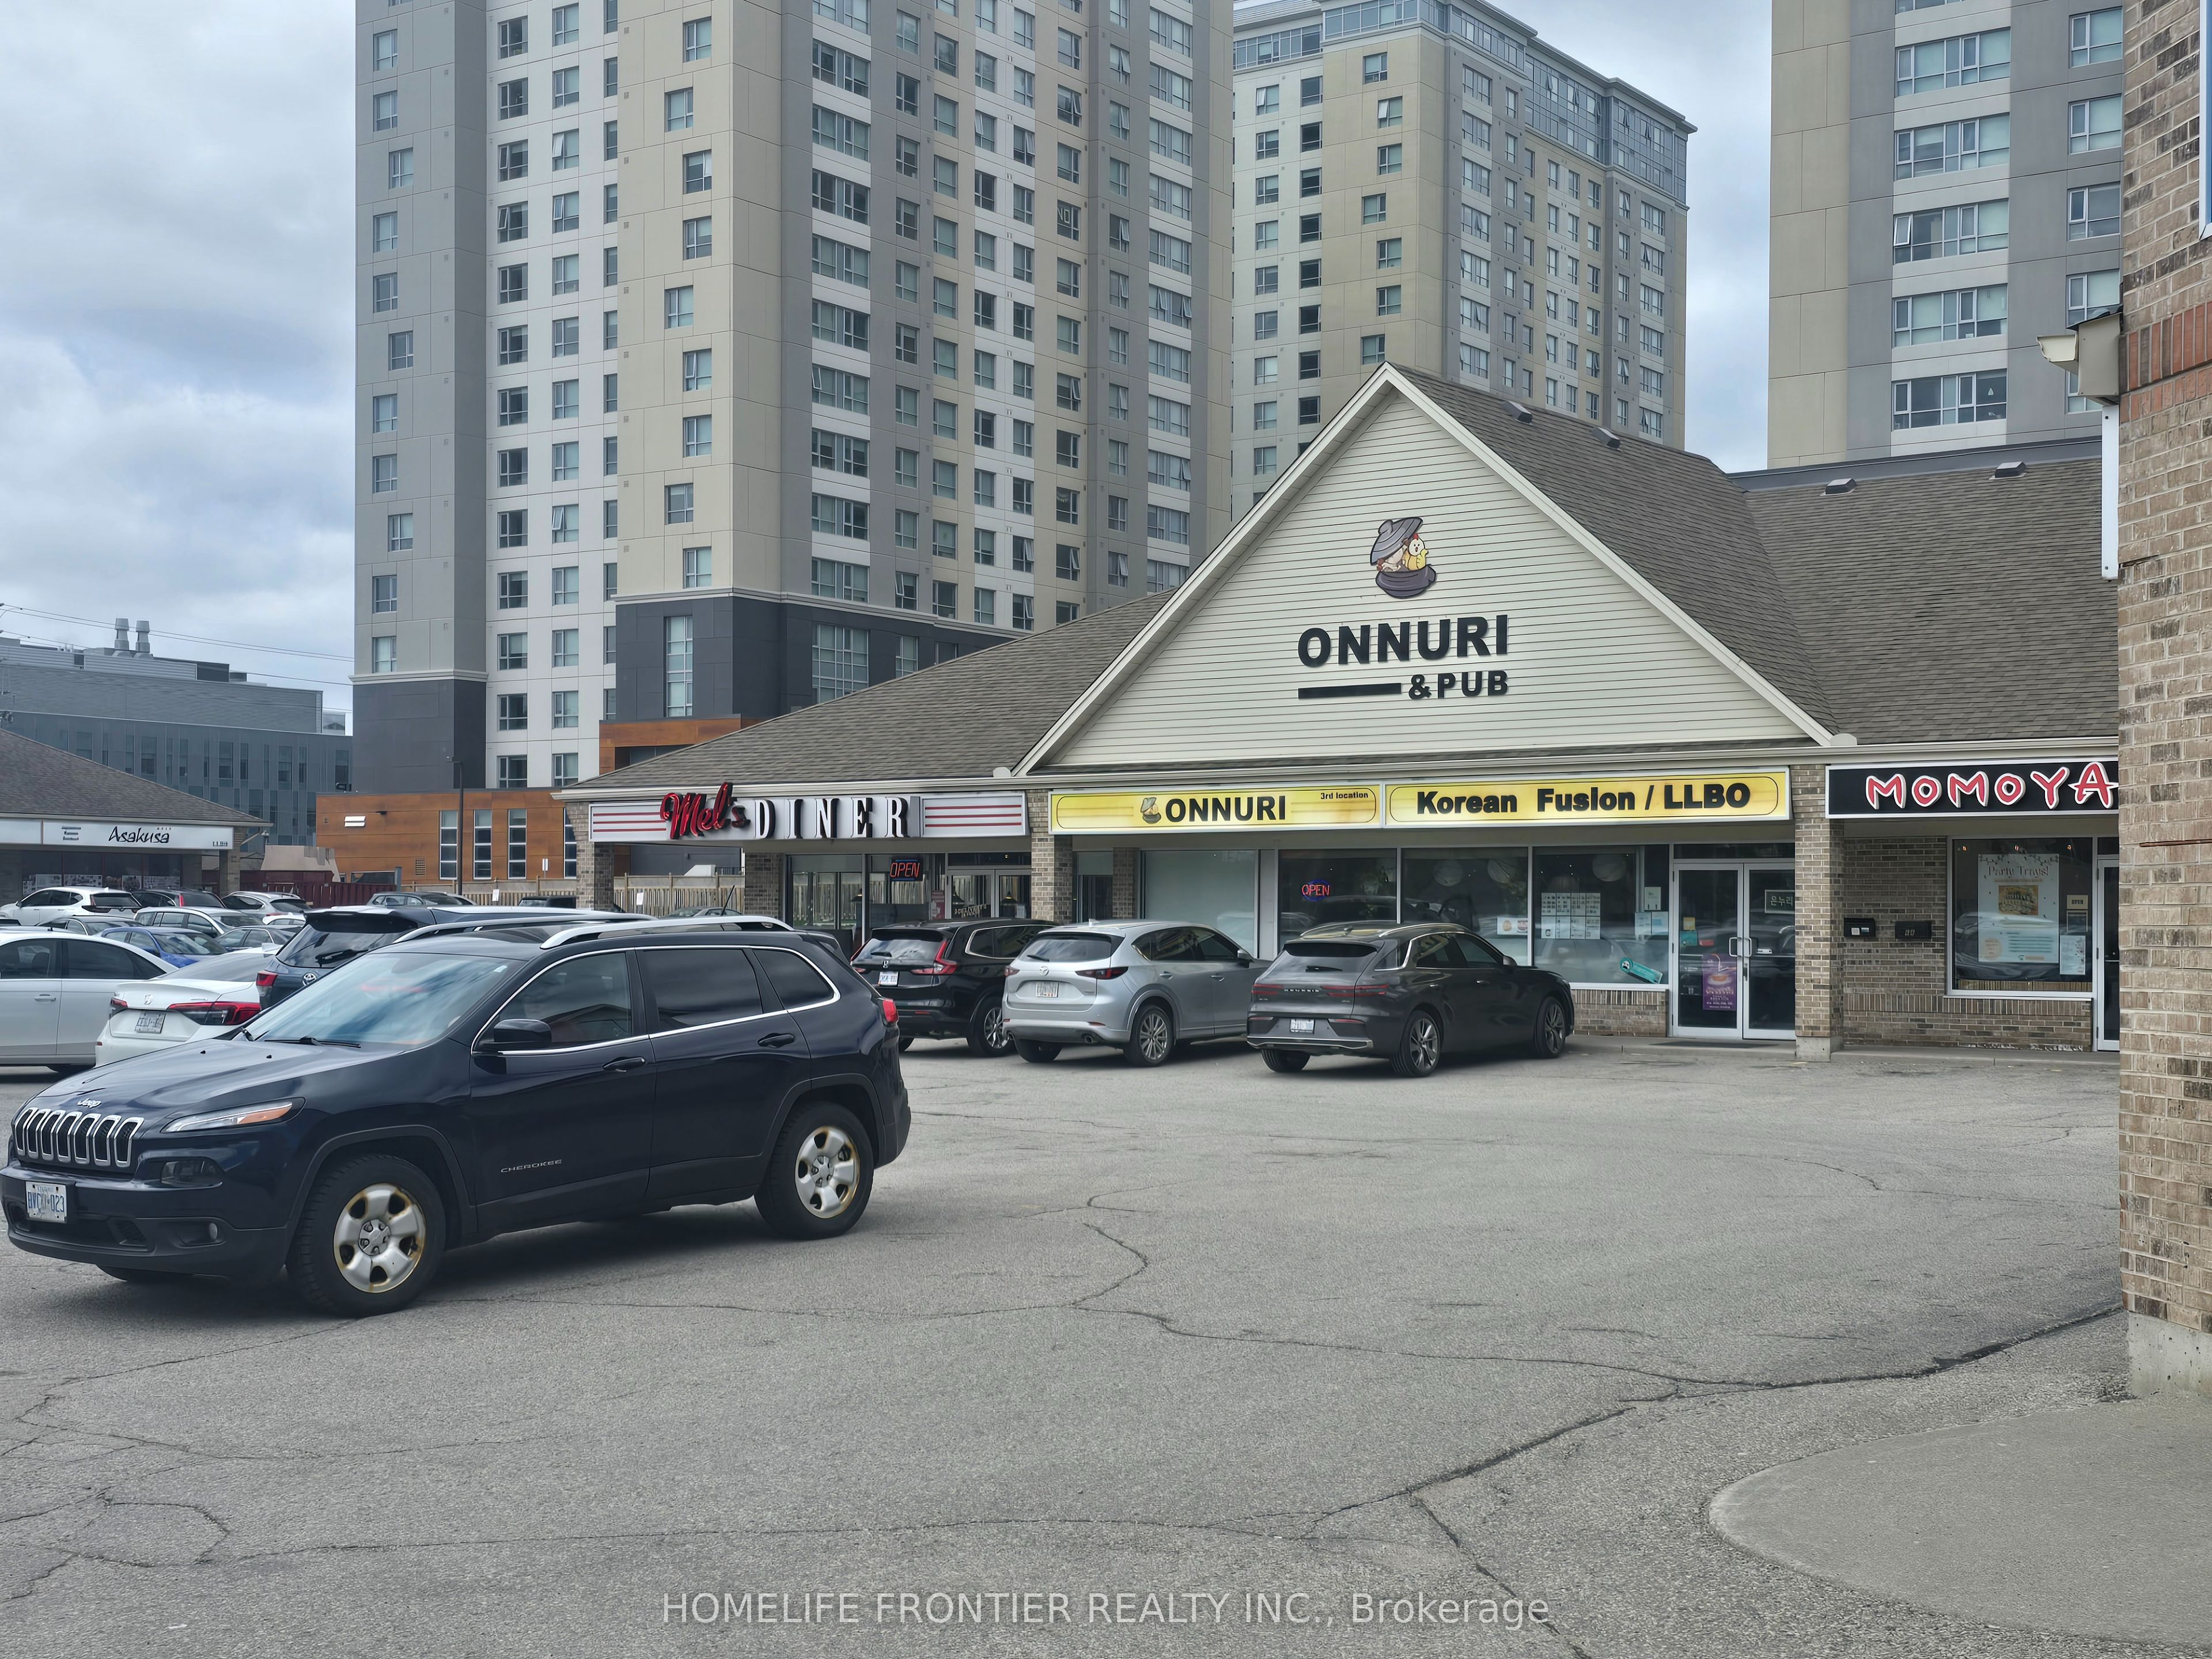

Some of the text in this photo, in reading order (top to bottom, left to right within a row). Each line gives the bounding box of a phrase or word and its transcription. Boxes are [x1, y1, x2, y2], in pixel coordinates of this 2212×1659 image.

[1298, 615, 1508, 668] ONNURI
[1866, 762, 2119, 809] MOMOYA
[1165, 796, 1286, 822] ONNURI
[1416, 791, 1517, 814] Korean
[1537, 787, 1635, 812] Fusion
[1664, 783, 1751, 809] LLBO
[660, 782, 908, 840] Mel's DINER
[108, 826, 171, 844] Asakusa
[889, 862, 921, 878] OPEN
[1988, 866, 2014, 877] Party
[1302, 884, 1330, 896] OPEN
[501, 1159, 562, 1173] CHEROKEE
